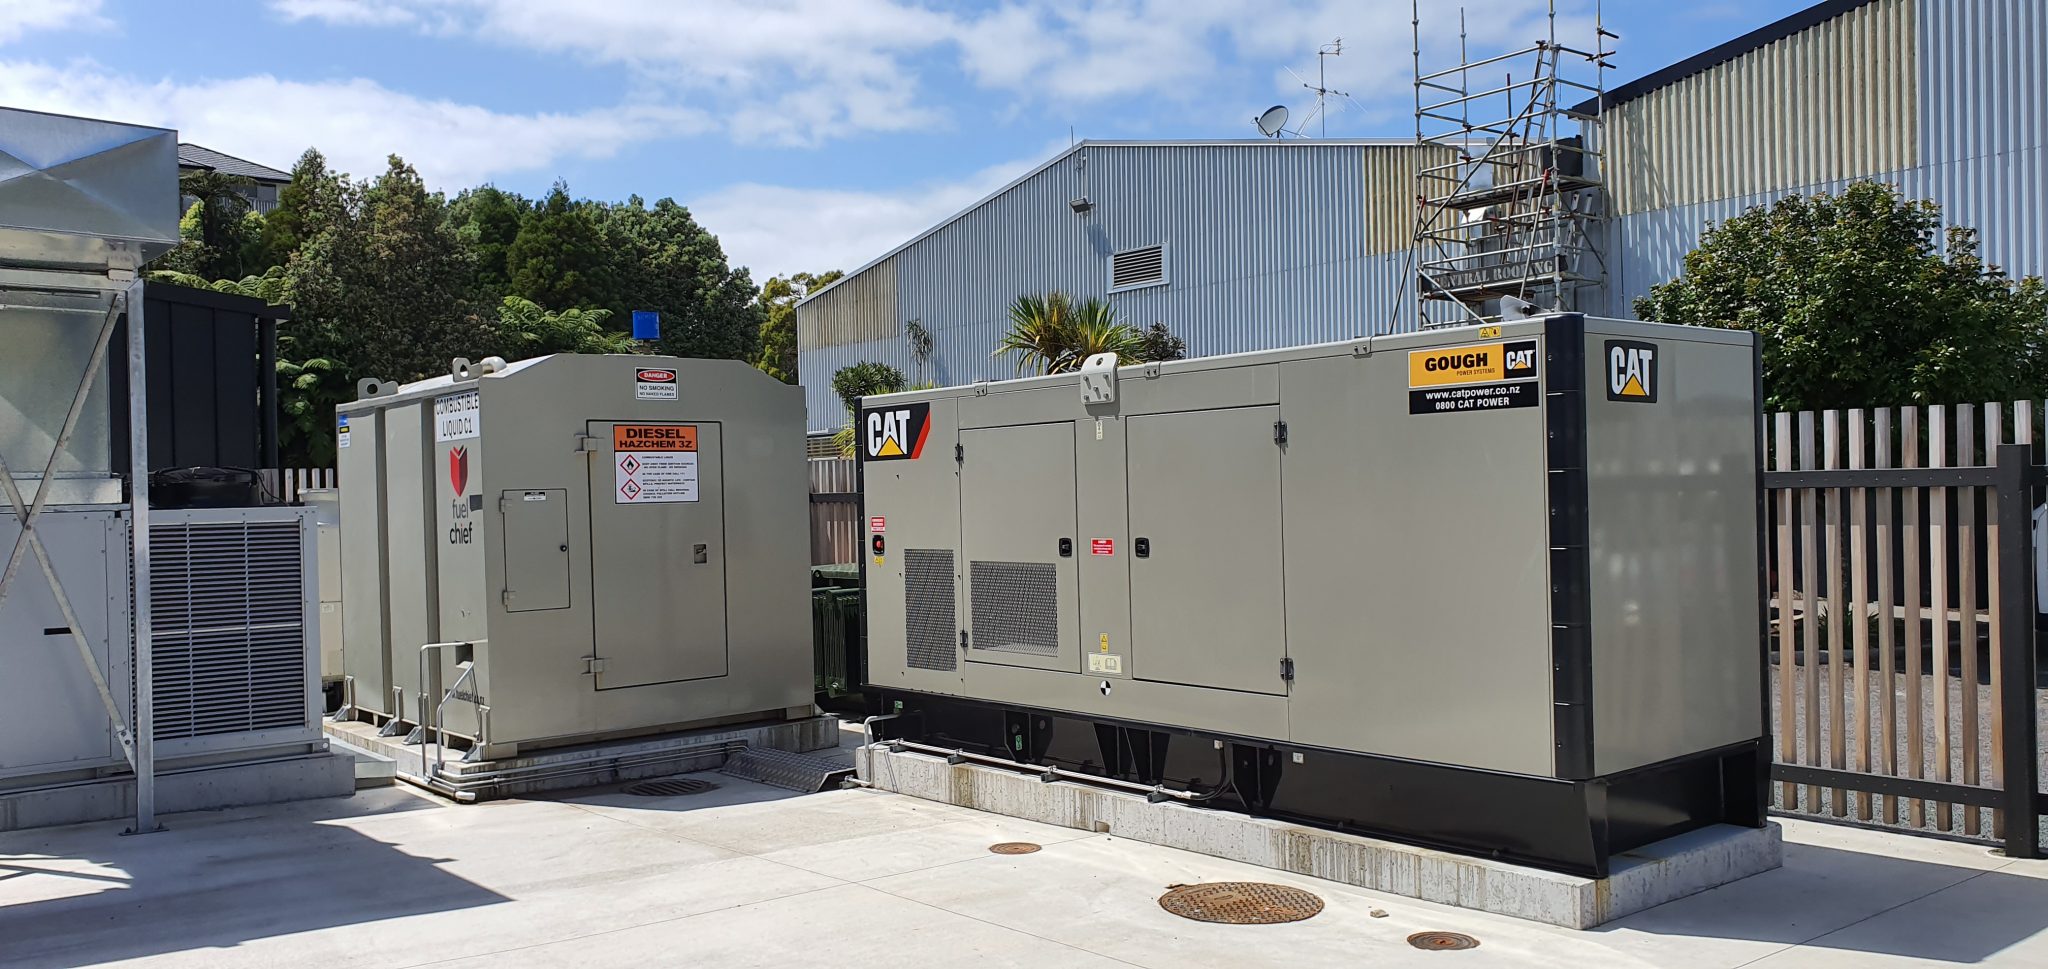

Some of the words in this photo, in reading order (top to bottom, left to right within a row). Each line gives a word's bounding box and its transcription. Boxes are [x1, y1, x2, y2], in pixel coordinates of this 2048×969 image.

[1425, 352, 1488, 372] GOUGH
[1506, 349, 1534, 370] CAT
[1611, 346, 1652, 396] CAT
[436, 391, 479, 415] COMBUSTIBLE
[1425, 386, 1520, 400] www.catpower.co.nz
[1435, 401, 1456, 410] 0800
[1458, 399, 1474, 409] CAT
[1477, 397, 1510, 408] POWER
[443, 418, 463, 439] LIQUID
[464, 417, 473, 434] C1
[626, 428, 686, 439] DIESEL
[867, 410, 911, 457] CAT
[619, 440, 676, 448] HAZCHEM
[678, 440, 693, 448] 3Z
[452, 498, 469, 519] fuel
[449, 521, 473, 545] chief
